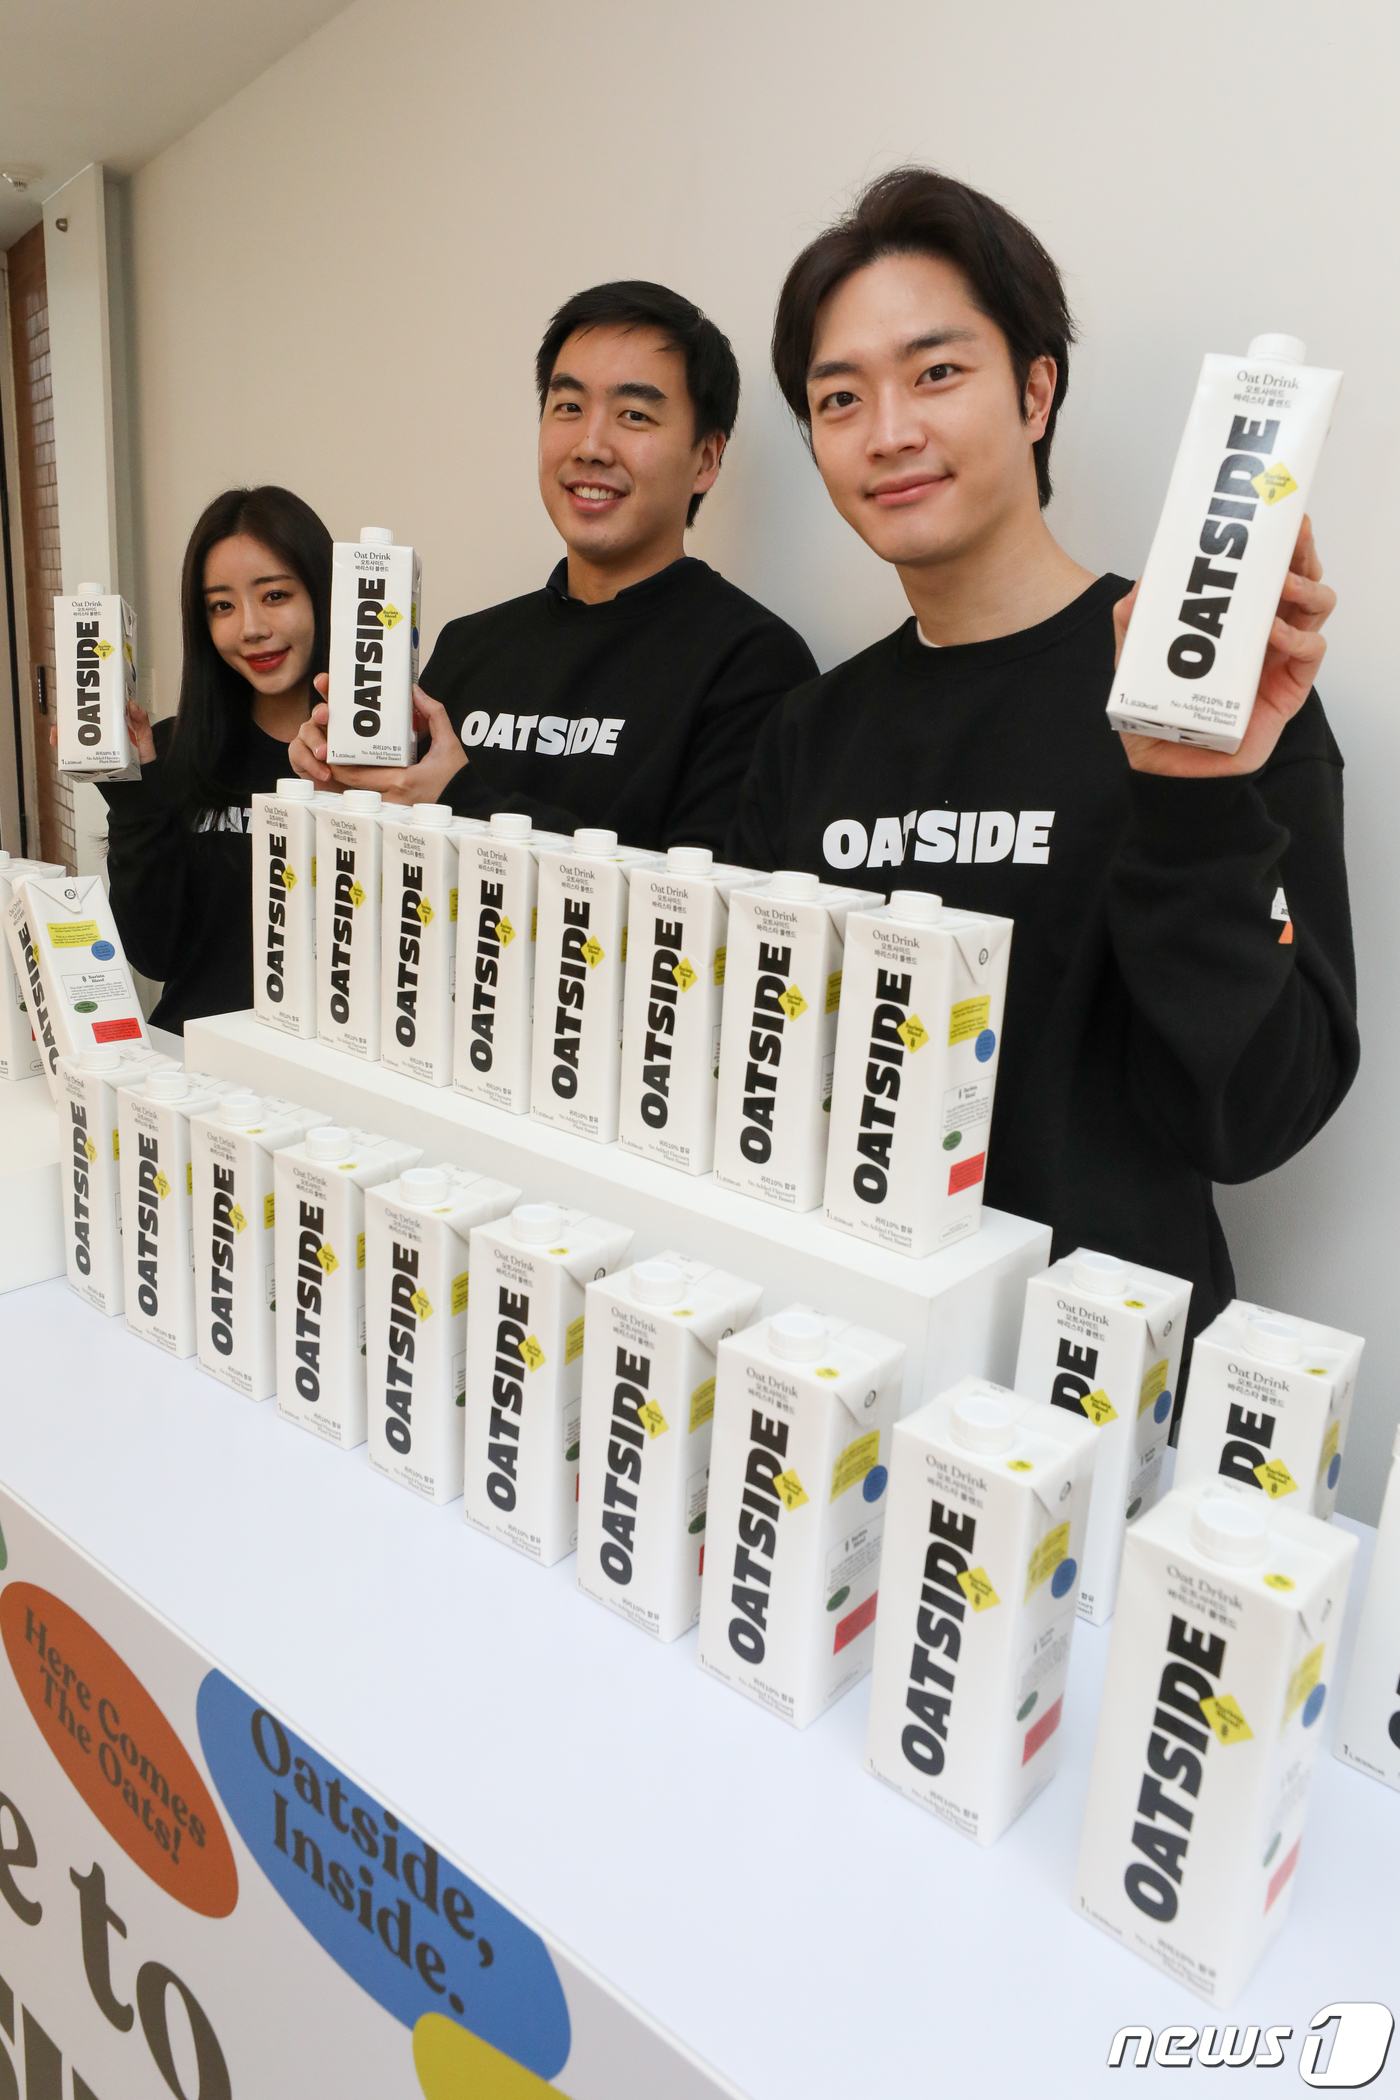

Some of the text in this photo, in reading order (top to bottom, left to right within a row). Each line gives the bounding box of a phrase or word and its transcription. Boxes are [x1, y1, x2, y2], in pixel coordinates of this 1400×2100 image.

[1237, 370, 1299, 389] Oat Drink
[370, 552, 391, 560] Drink
[1167, 414, 1280, 679] OATSIDE
[77, 621, 101, 746] OATSIDE
[353, 578, 385, 737] OATSIDE
[460, 710, 626, 756] OATSIDE
[330, 818, 356, 830] Oat Drink
[397, 832, 425, 845] Oat Drink
[477, 847, 508, 861] Oat Drink
[559, 864, 594, 879] Oat Drink
[650, 883, 688, 898] Oat Drink
[822, 809, 1056, 869] OATSIDE
[266, 833, 286, 1002] OATSIDE
[330, 848, 354, 1023] OATSIDE
[395, 863, 422, 1046] OATSIDE
[469, 879, 503, 1071] OATSIDE
[551, 898, 589, 1098] OATSIDE
[754, 906, 797, 922] Oat Drink
[872, 929, 919, 948] Oat Drink
[640, 918, 682, 1128] OATSIDE
[739, 942, 790, 1163] OATSIDE
[853, 968, 911, 1203] OATSIDE
[71, 1101, 90, 1275] OATSIDE
[138, 1132, 158, 1316] OATSIDE
[211, 1163, 234, 1354] OATSIDE
[494, 1249, 534, 1272] Oat Drink
[295, 1200, 323, 1401] OATSIDE
[385, 1241, 418, 1454] OATSIDE
[611, 1307, 656, 1334] Oat Drink
[746, 1367, 798, 1397] Oat Drink
[1056, 1300, 1108, 1326] Oat Drink
[1227, 1364, 1289, 1391] Oat Drink
[486, 1285, 528, 1511] OATSIDE
[599, 1345, 649, 1584] OATSIDE
[925, 1455, 986, 1491] Oat Drink
[727, 1408, 788, 1663] OATSIDE
[901, 1499, 975, 1776] OATSIDE
[25, 1606, 206, 1848] Here Comes
[40, 1664, 181, 1865] The Oats!
[1124, 1613, 1224, 1922] OATSIDE
[251, 1708, 494, 1969] Oatside,
[273, 1788, 464, 2015] Inside.
[70, 1862, 232, 2100] to
